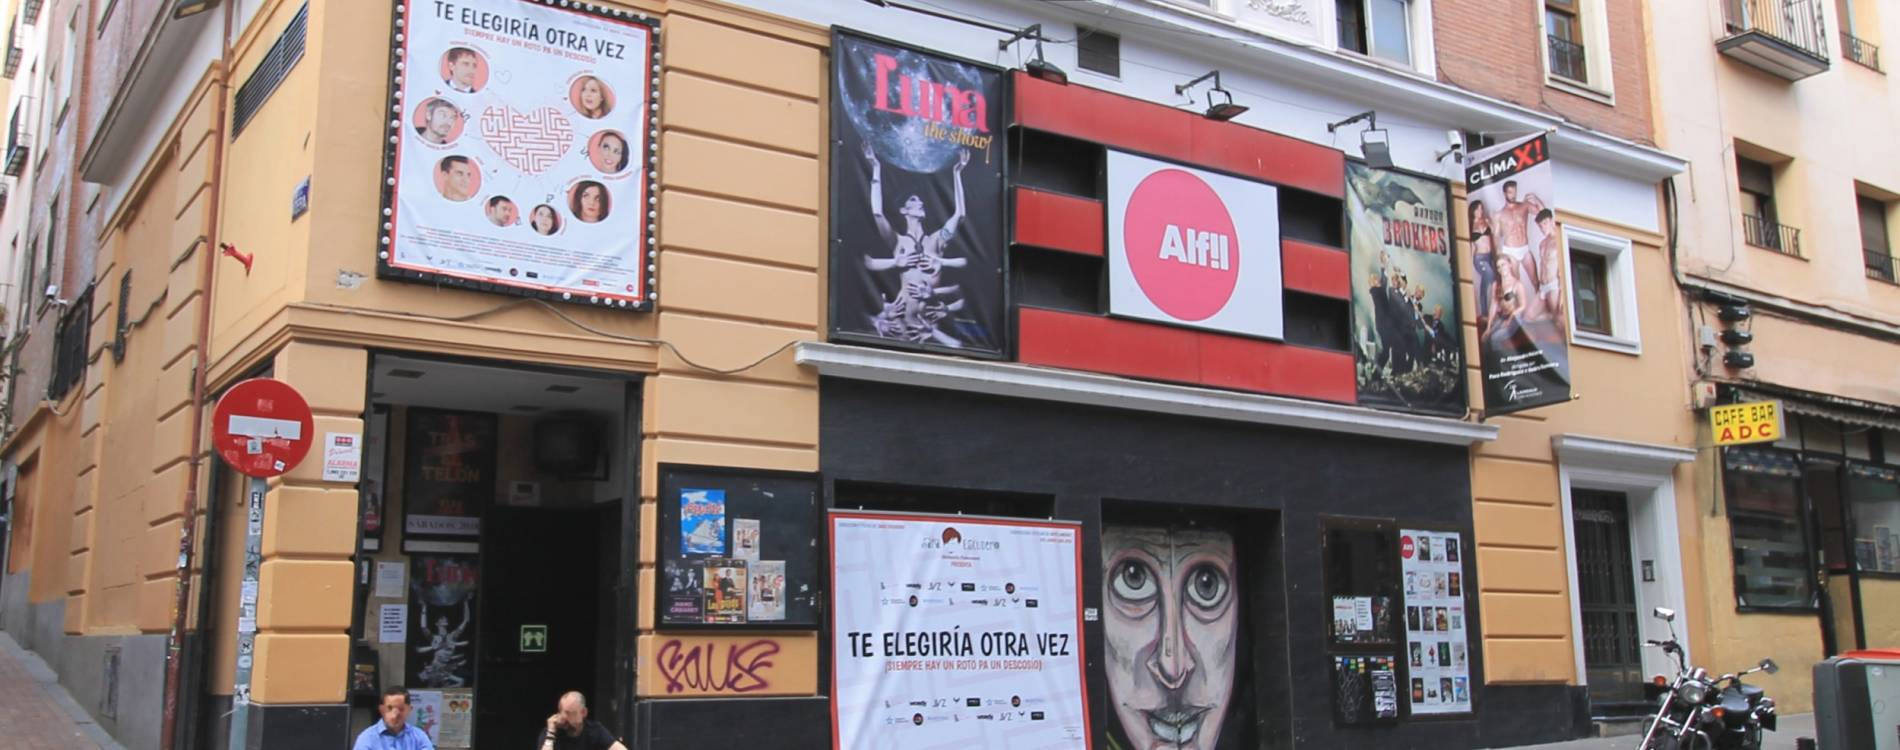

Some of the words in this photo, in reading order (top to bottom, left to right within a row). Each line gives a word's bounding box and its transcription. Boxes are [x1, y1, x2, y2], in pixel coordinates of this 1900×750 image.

[434, 1, 455, 21] TE
[461, 8, 539, 41] ELEGIRÍA
[545, 26, 589, 53] OTRA
[594, 39, 625, 60] VEZ
[874, 53, 990, 133] Luna
[923, 121, 949, 141] the
[1383, 216, 1448, 257] BROKERS
[1715, 407, 1745, 426] CAFE
[1751, 404, 1774, 422] BAR
[848, 631, 874, 657] TE
[883, 625, 974, 657] ELEGIRÍA
[981, 632, 1029, 657] OTRA
[1036, 633, 1070, 657] VEZ
[925, 659, 942, 671] HAY
[943, 659, 954, 671] UN
[956, 659, 976, 671] ROTO
[979, 660, 988, 671] PA
[990, 660, 1001, 671] UN
